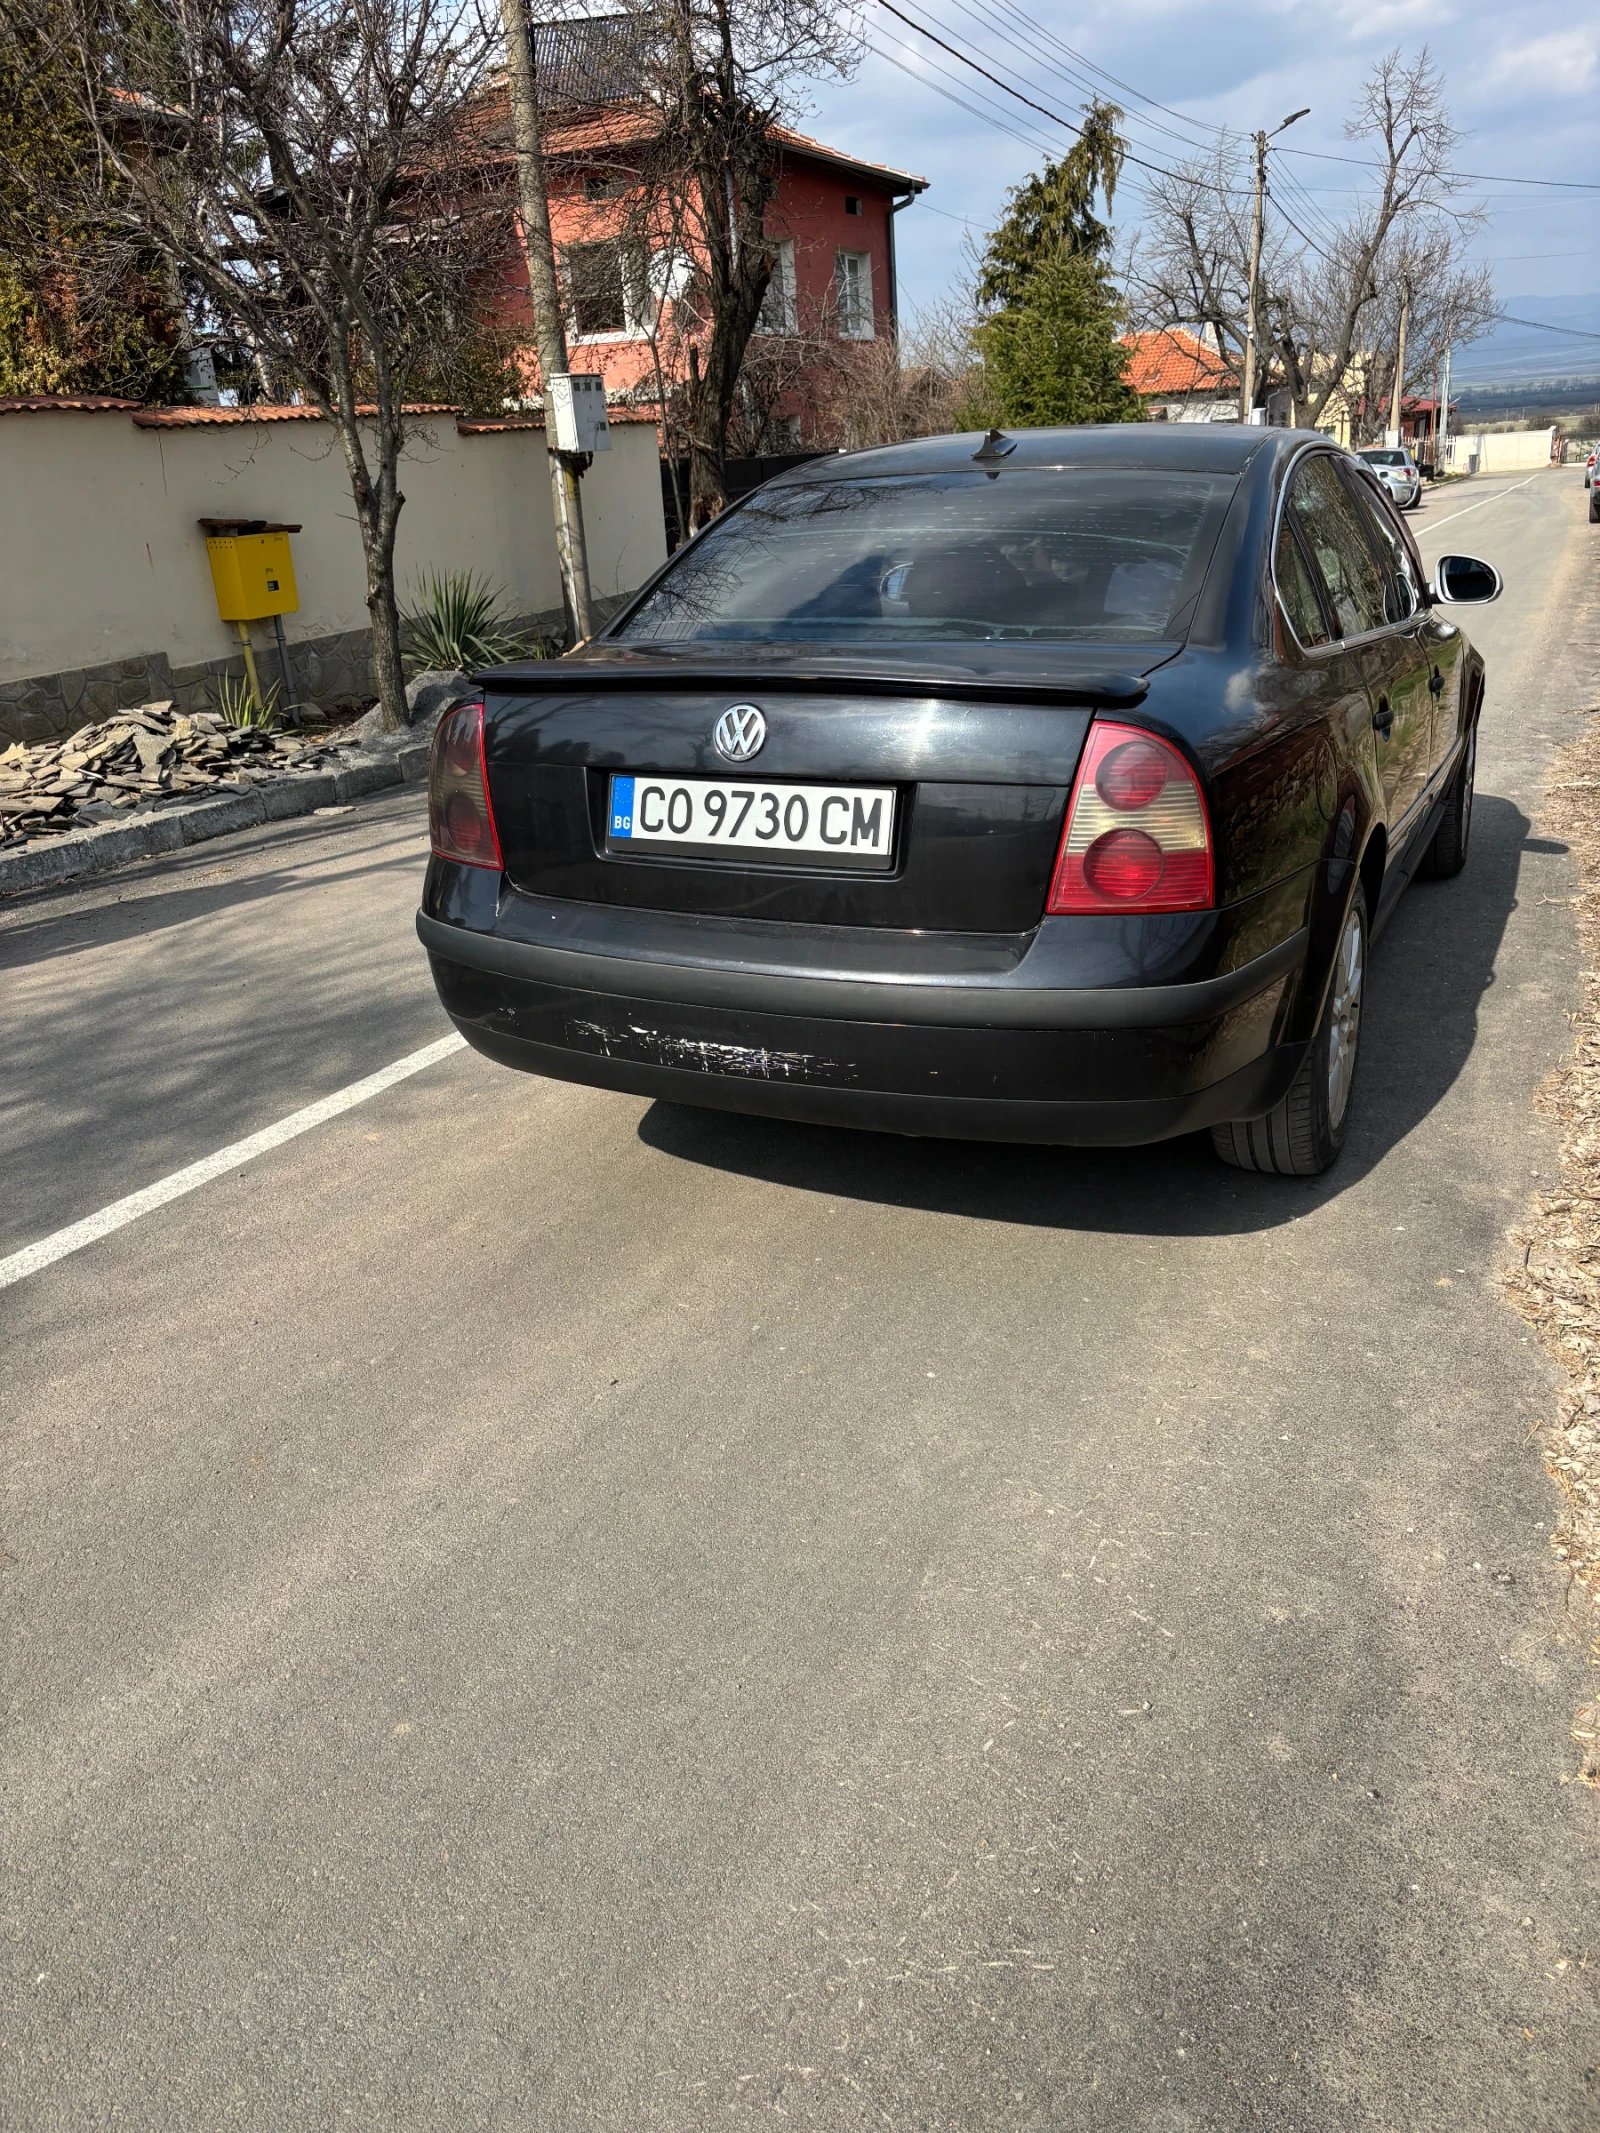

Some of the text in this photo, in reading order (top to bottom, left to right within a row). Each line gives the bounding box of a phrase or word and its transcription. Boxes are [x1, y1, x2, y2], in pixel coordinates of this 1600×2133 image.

[715, 703, 766, 762] VW
[614, 816, 631, 830] BG
[640, 786, 883, 847] CO 9730 CM
